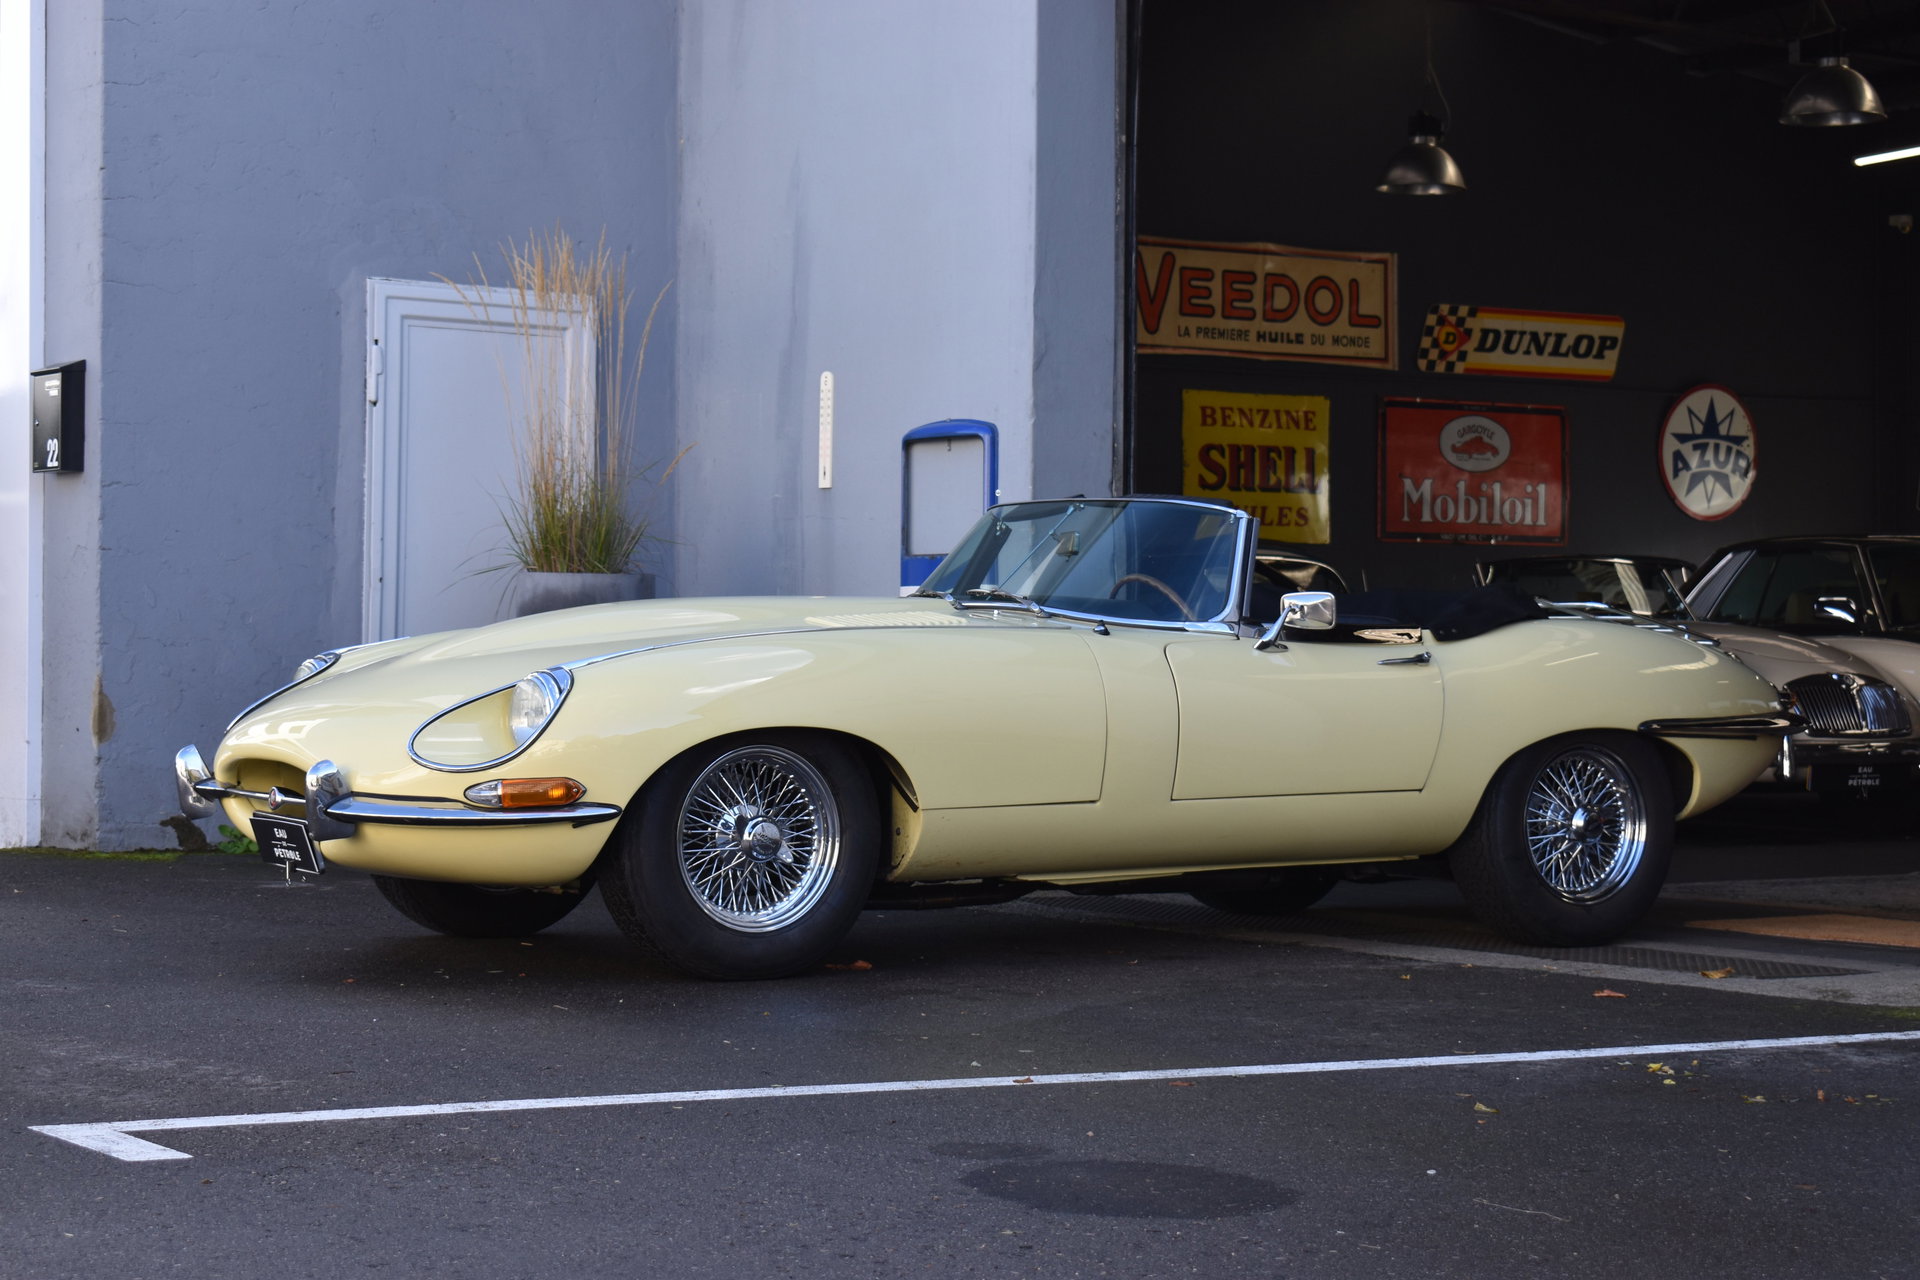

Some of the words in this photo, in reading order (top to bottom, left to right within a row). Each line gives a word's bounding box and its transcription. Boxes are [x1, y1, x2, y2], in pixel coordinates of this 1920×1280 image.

[1137, 251, 1381, 335] VEEDOL
[1177, 325, 1190, 338] LA
[1196, 326, 1250, 342] PREMIERE
[1256, 330, 1304, 345] HUILE
[1311, 332, 1325, 346] DU
[1332, 334, 1370, 348] MONDE
[1442, 331, 1457, 345] D
[1473, 328, 1619, 360] DUNLOP
[1199, 406, 1317, 431] BENZINE
[46, 438, 59, 467] 22
[1672, 442, 1752, 482] AZUR
[1198, 443, 1322, 495] SHELL
[1401, 478, 1548, 526] Mobiloil
[273, 828, 288, 839] EAU
[273, 845, 302, 861] PÉTROLE
